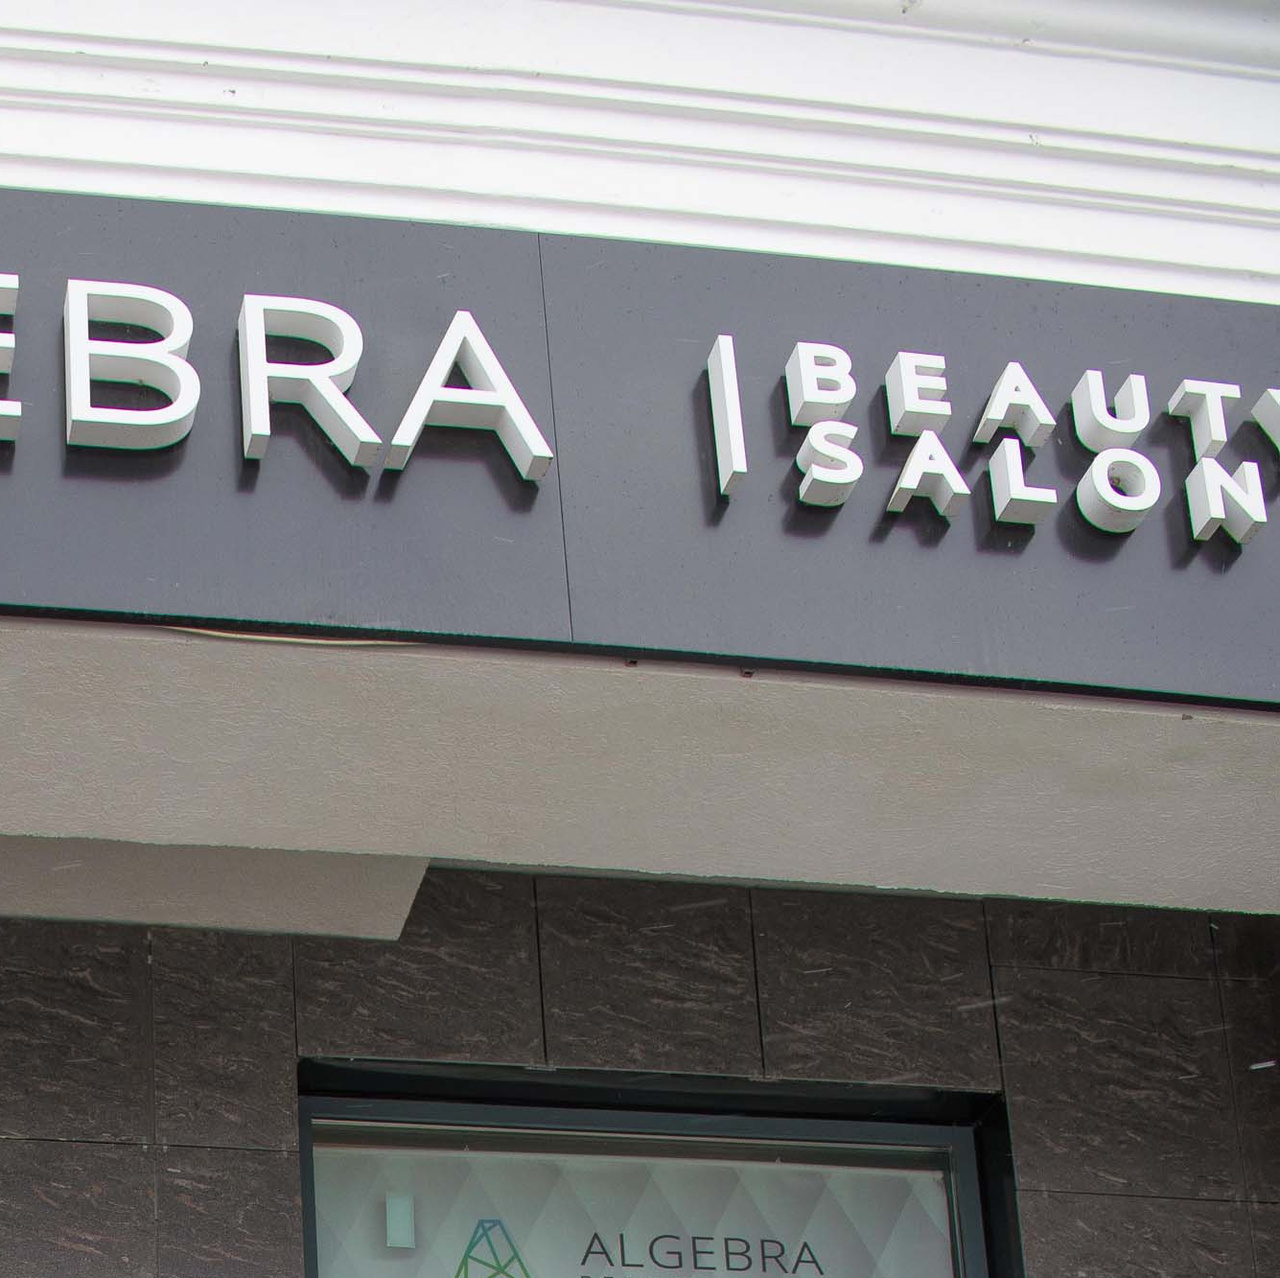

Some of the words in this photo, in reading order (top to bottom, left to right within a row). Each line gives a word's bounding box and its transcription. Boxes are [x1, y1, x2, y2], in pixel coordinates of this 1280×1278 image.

[785, 342, 1280, 460] BEAUT
[796, 420, 1267, 544] SALON
[580, 1232, 825, 1276] ALGEBRA
